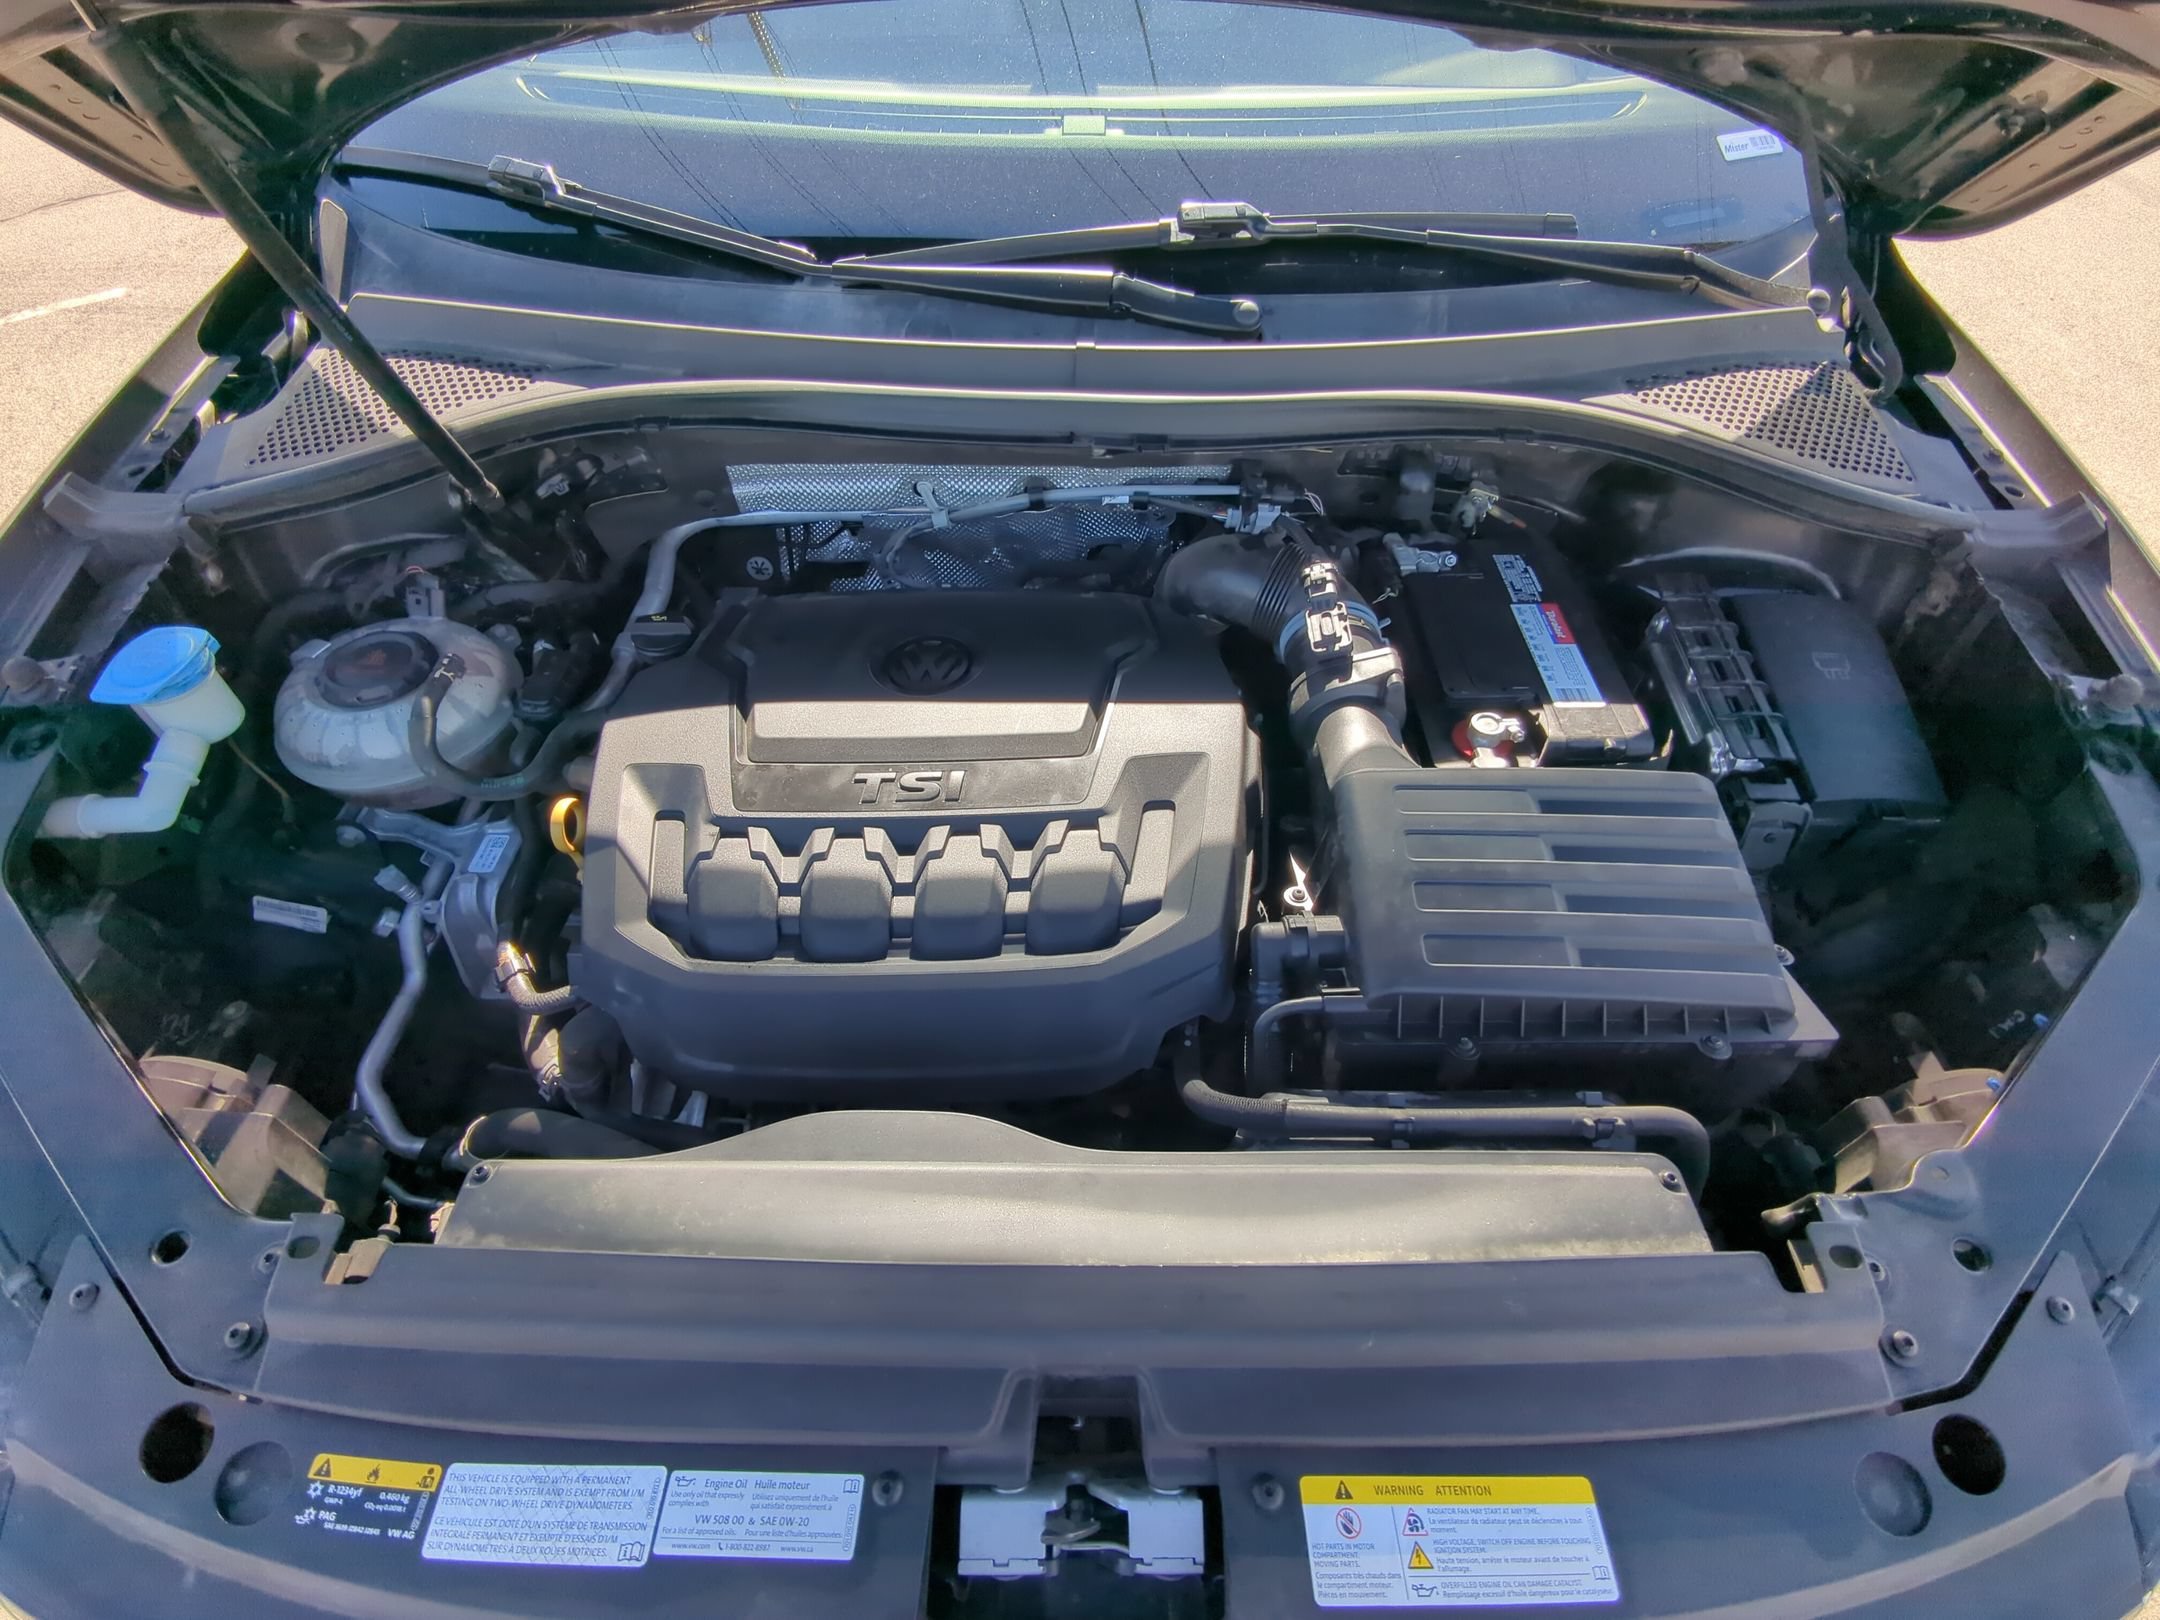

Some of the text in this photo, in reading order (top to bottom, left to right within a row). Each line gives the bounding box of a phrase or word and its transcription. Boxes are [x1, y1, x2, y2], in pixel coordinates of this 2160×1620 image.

[1724, 142, 1749, 154] Mister
[852, 770, 967, 805] TSI
[449, 1473, 632, 1485] THIS VEHICLE IS EQUIPPED WITH A PERMANENT
[704, 1478, 810, 1490] Engine Oil Huile moteur
[444, 1485, 646, 1497] ALL-WHEEL DRIVE SYSTEM AND IS EXEMPT FROM I/M
[1373, 1485, 1492, 1496] WARNING ATTENTION
[441, 1496, 472, 1506] TESTING
[474, 1498, 487, 1506] ON
[488, 1498, 538, 1508] TWO-WHEEL
[540, 1500, 565, 1508] DRIVE
[318, 1510, 337, 1520] PAG
[695, 1514, 810, 1527] VW 508 00 & SAE 0W-20
[388, 1528, 402, 1538] VW
[402, 1530, 416, 1540] AG
[427, 1540, 444, 1550] SUR
[516, 1546, 538, 1556] DEUX
[540, 1546, 566, 1556] ROUES
